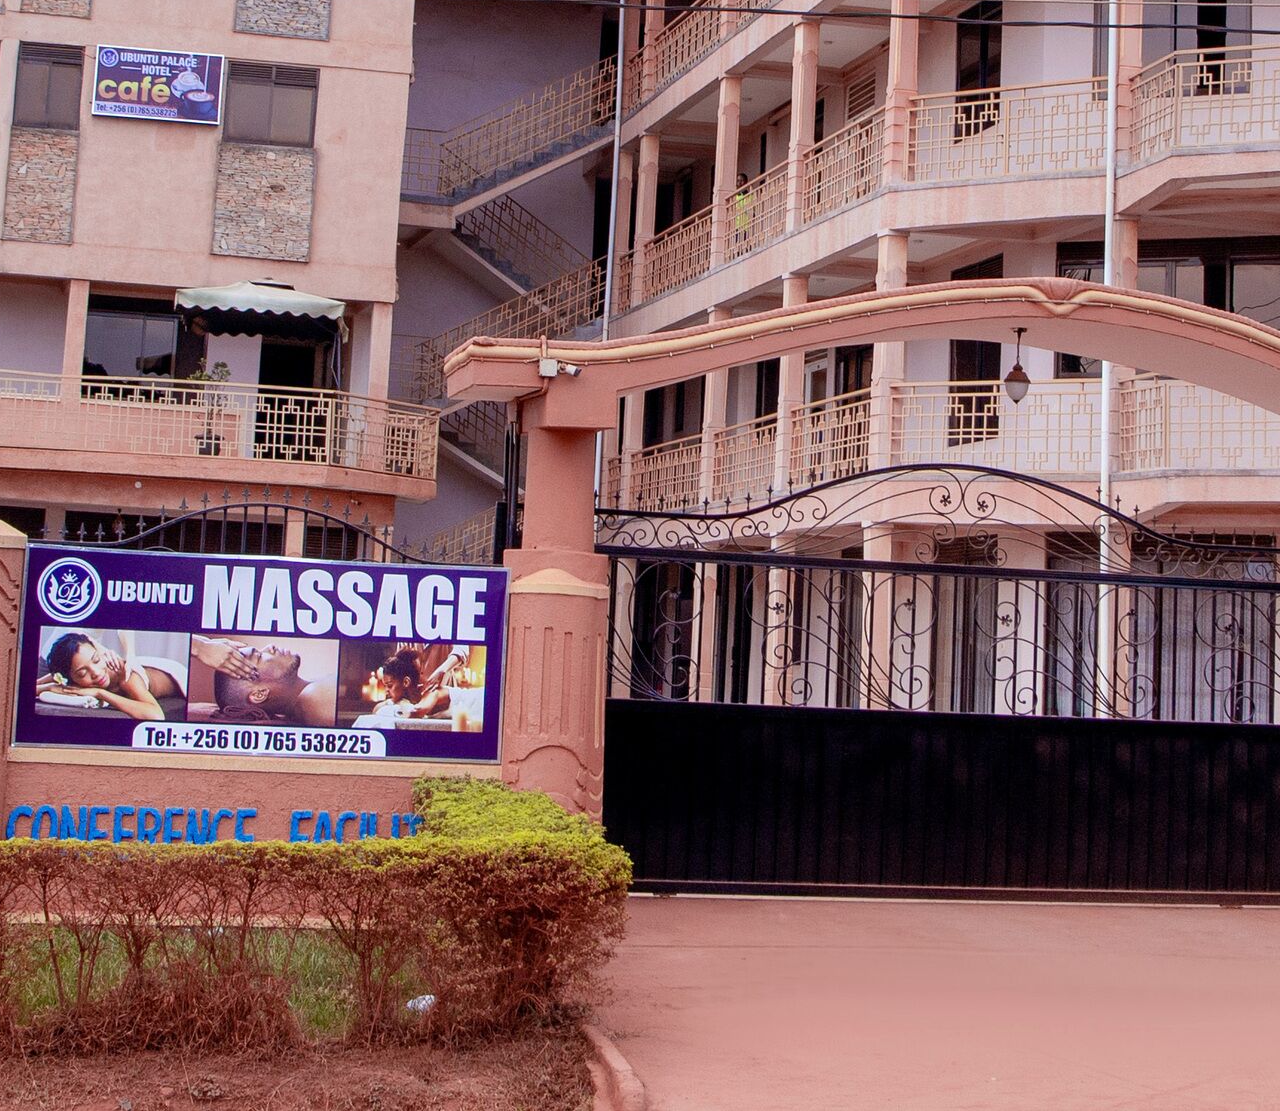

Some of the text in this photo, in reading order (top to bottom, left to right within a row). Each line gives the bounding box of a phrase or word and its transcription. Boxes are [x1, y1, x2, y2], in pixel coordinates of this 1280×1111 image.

[120, 52, 198, 68] UBUNTU PALACE
[141, 64, 172, 76] HOTEL
[98, 75, 171, 104] café
[106, 563, 487, 643] UBUNTU MASSAGE
[144, 726, 372, 756] Tel: +256 (0) 765 538225
